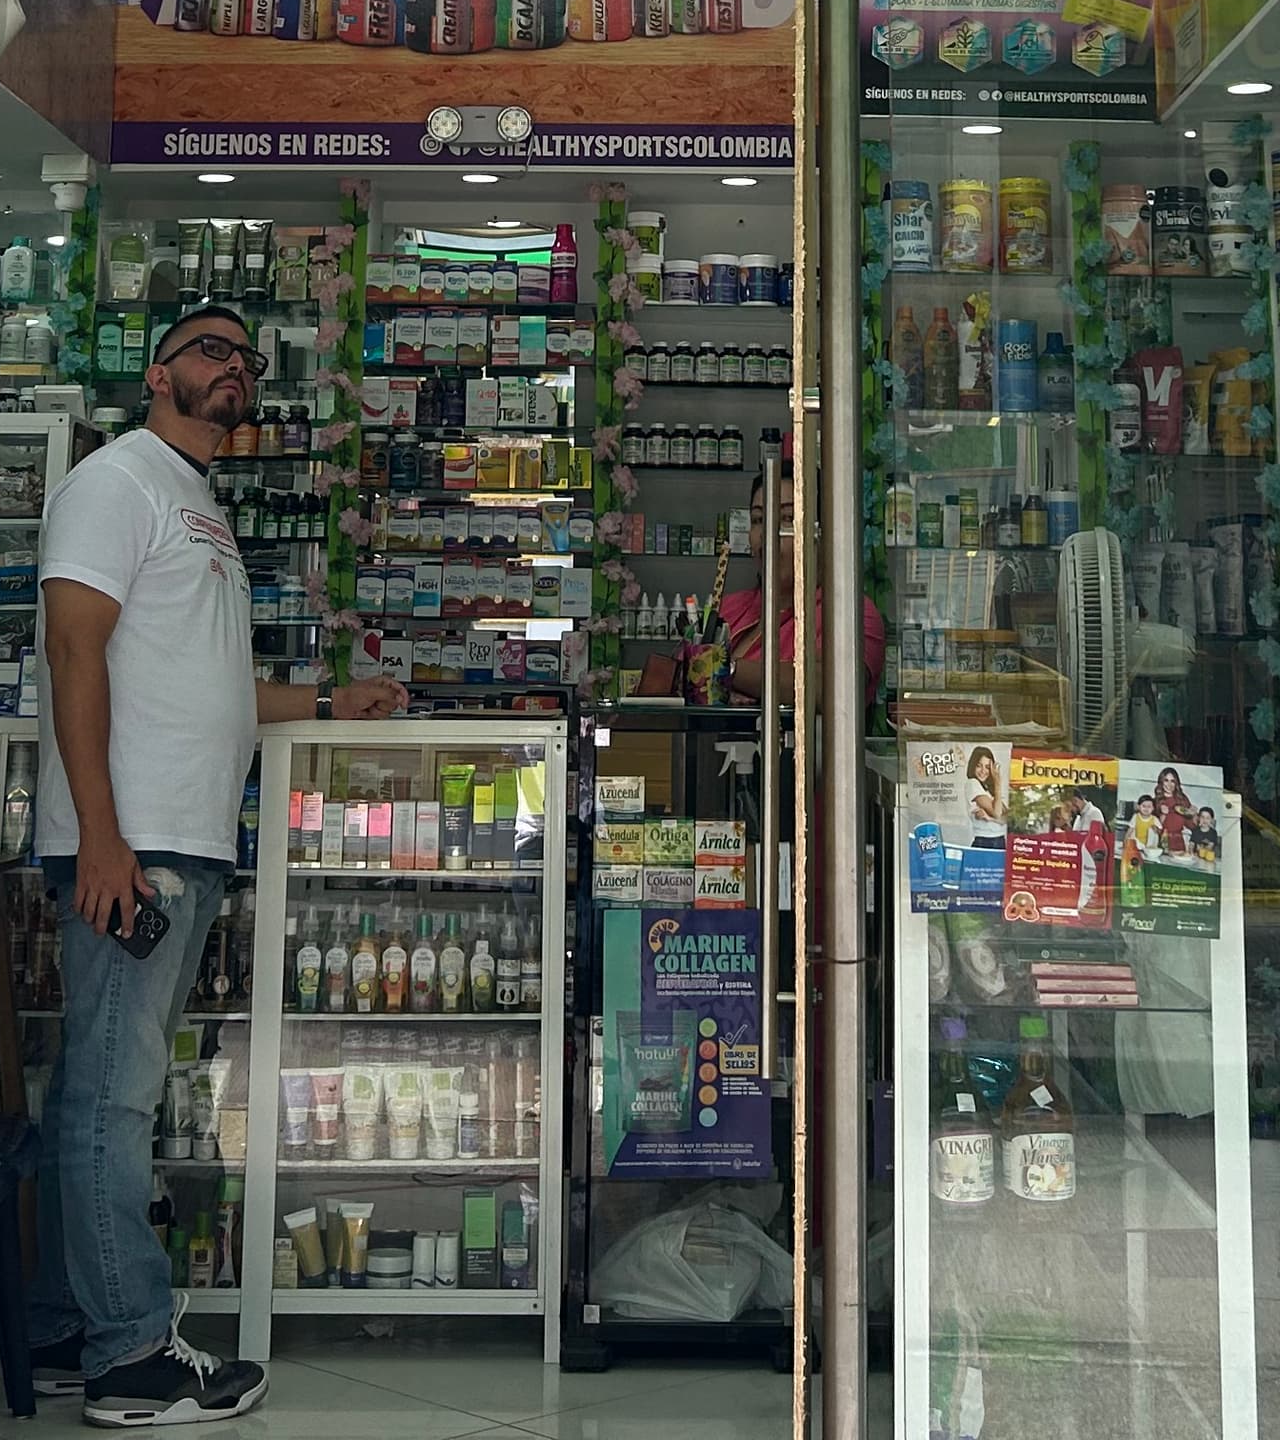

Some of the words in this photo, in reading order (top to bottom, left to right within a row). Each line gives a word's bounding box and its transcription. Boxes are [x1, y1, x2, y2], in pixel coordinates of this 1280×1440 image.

[648, 6, 662, 33] KRE
[865, 87, 913, 101] SÍGUENOS
[915, 89, 929, 100] EN
[931, 89, 967, 101] REDES:
[1004, 91, 1148, 105] @HEALTHYSPORTSCOLOMBIA
[163, 128, 273, 157] SÍGUENOS
[279, 133, 308, 157] EN
[314, 133, 392, 158] REDES:
[417, 581, 438, 590] HGH
[381, 656, 404, 667] PSA
[598, 782, 641, 800] Azucena
[650, 828, 689, 844] Ortiga
[596, 872, 639, 889] Azucena
[663, 934, 747, 953] MARINE
[654, 954, 756, 973] COLLAGEN
[635, 1091, 678, 1102] MARINE
[631, 1101, 683, 1112] COLLAGEN
